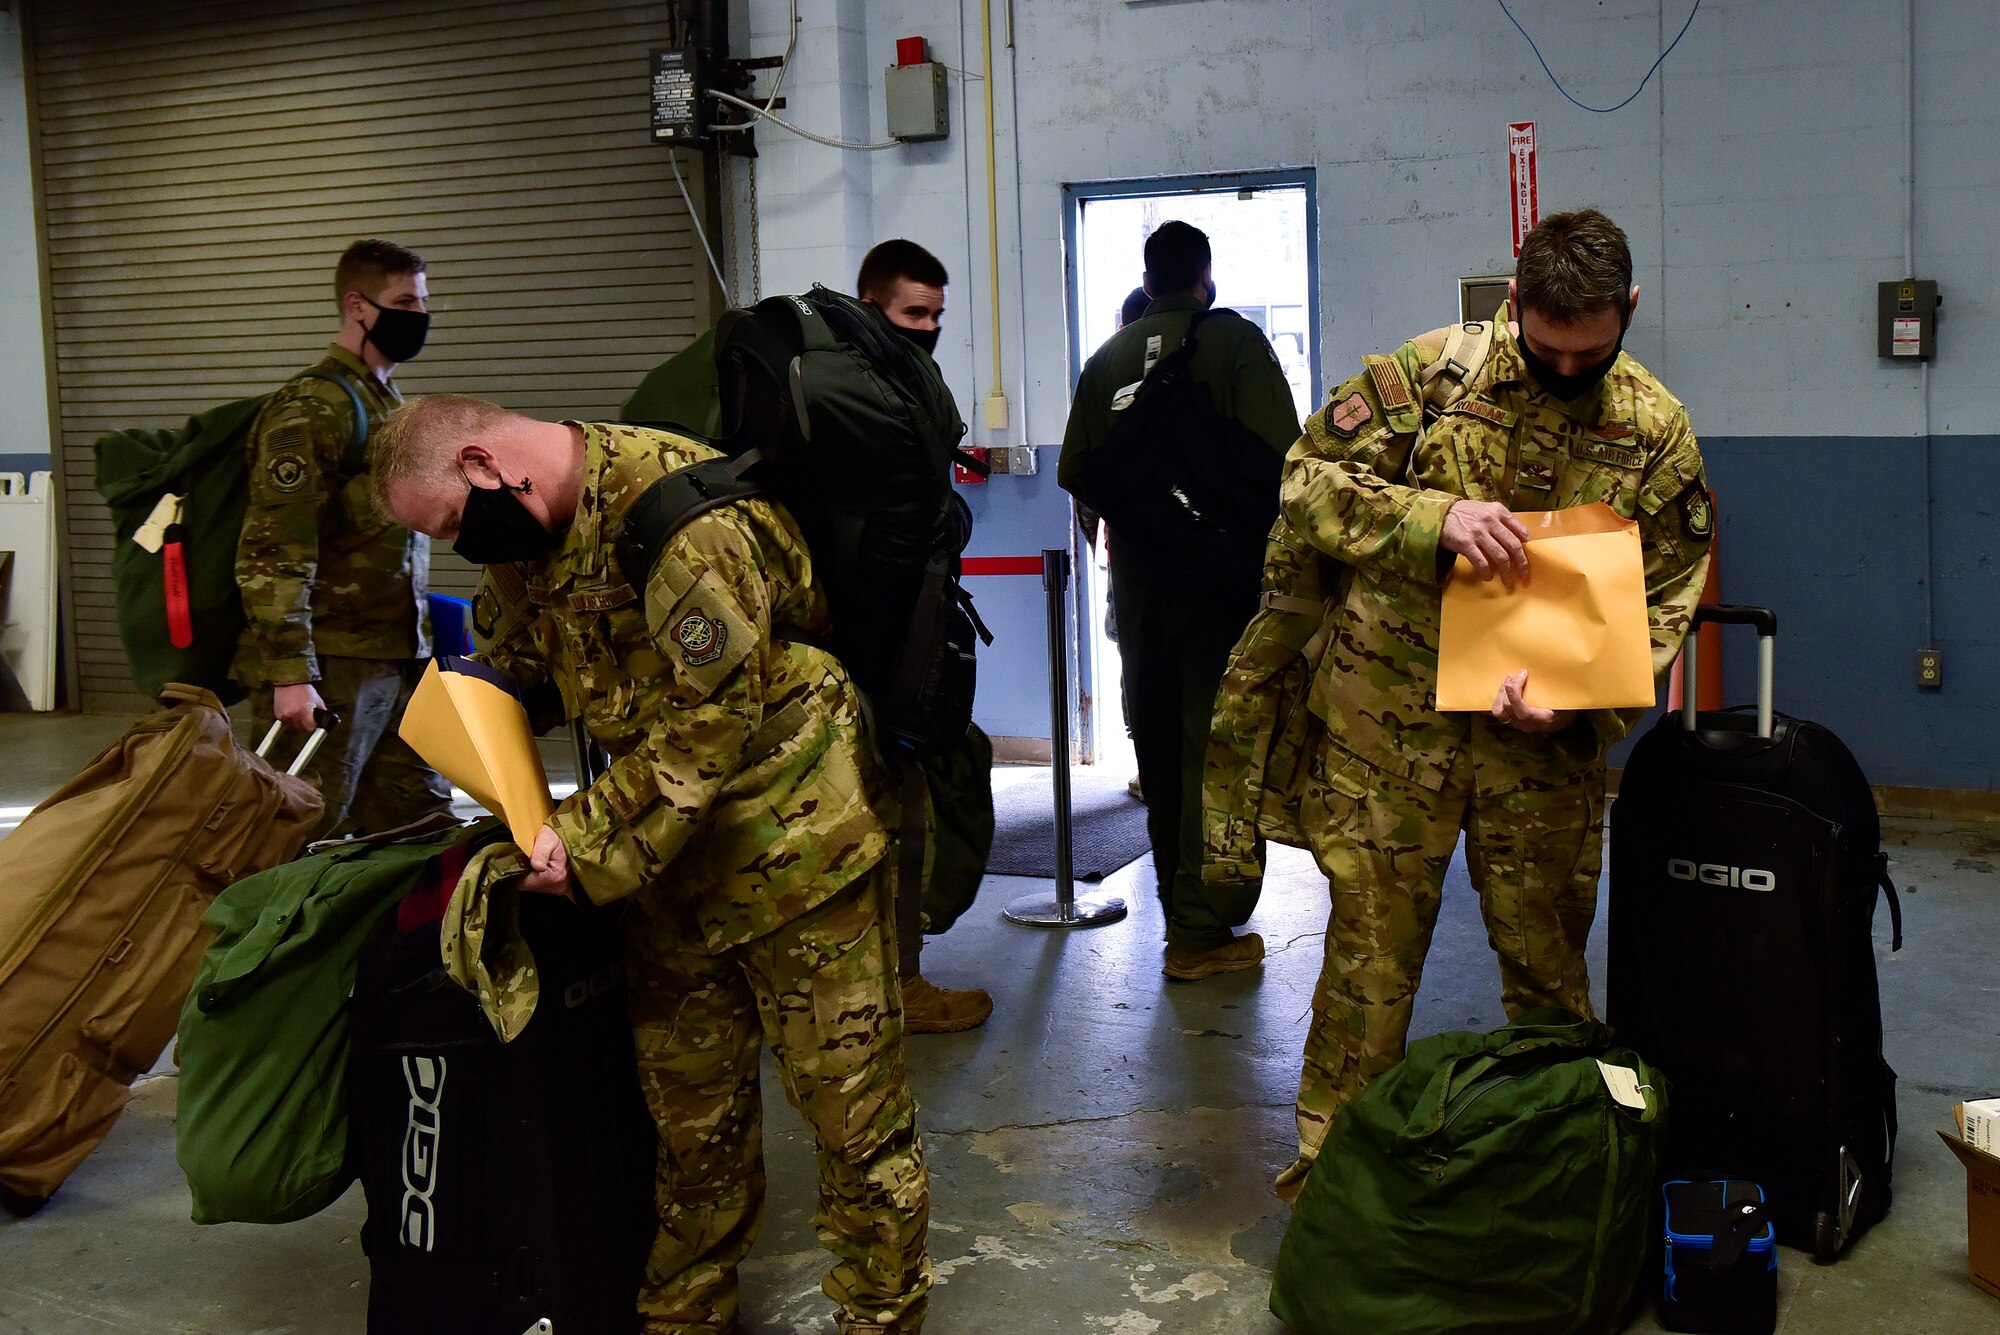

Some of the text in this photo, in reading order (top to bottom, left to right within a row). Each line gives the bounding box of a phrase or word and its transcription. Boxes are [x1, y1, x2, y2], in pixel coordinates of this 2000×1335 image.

[1512, 136, 1531, 146] FIRE
[1519, 149, 1529, 240] EXTINGUISHE
[1598, 446, 1615, 462] AIR
[1616, 451, 1645, 467] FORCE
[1667, 859, 1776, 892] OGIO
[565, 963, 624, 1009] OGI
[399, 1055, 447, 1252] OGIO
